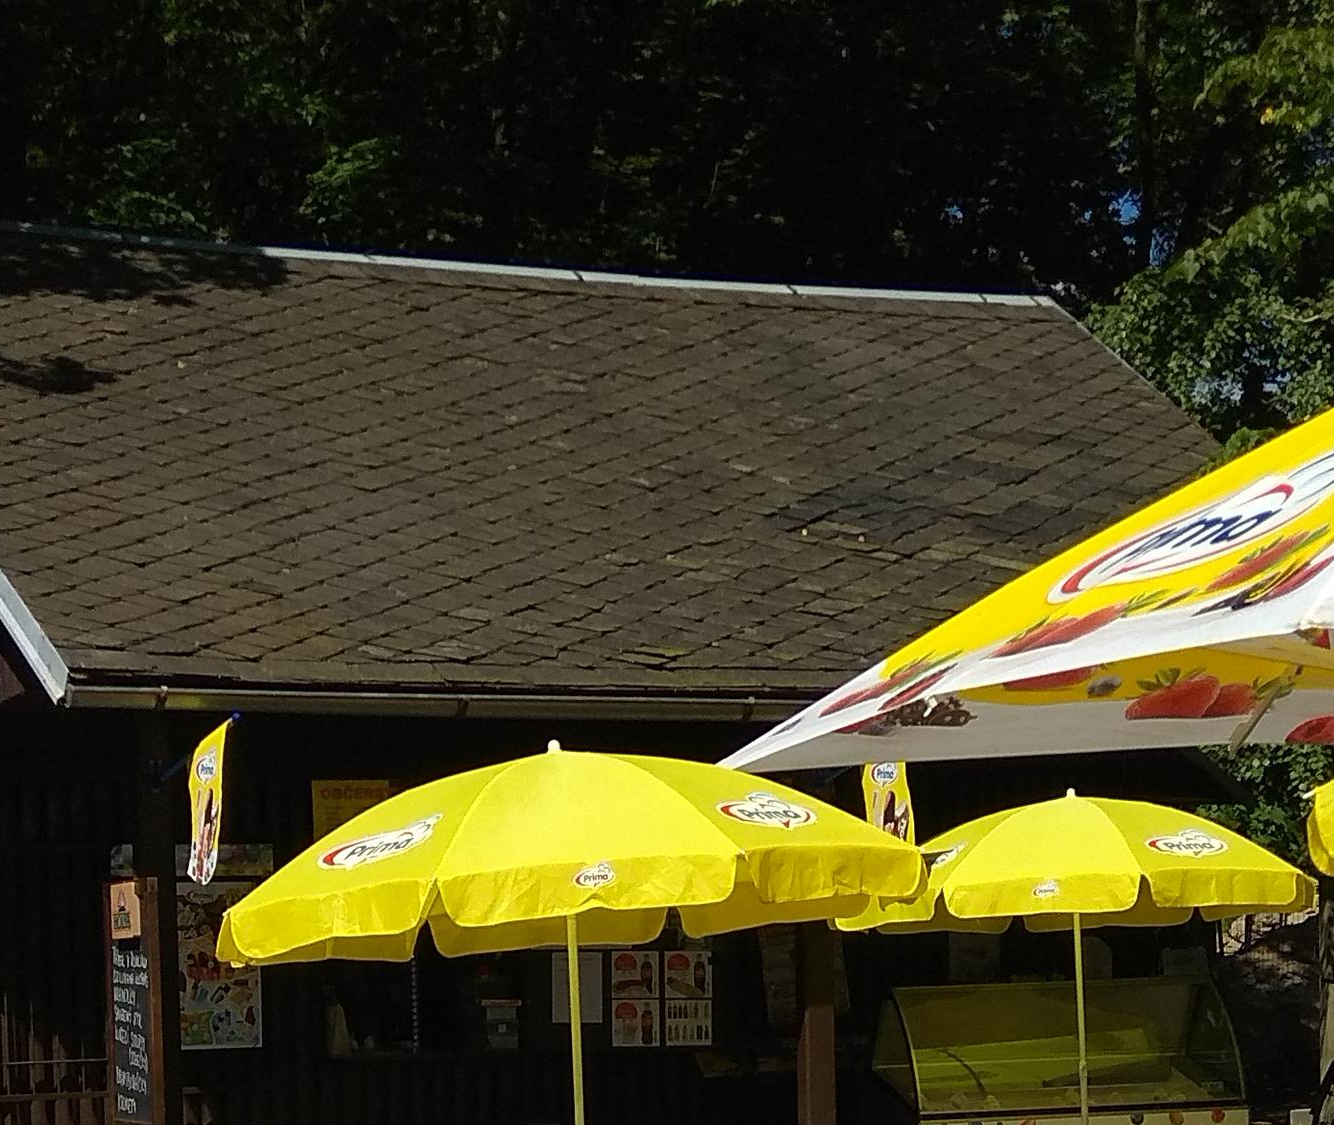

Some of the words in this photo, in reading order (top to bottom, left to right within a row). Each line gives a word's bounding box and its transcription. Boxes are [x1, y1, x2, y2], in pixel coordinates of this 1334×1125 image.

[740, 804, 799, 826] Prima
[343, 836, 415, 862] Prima
[1163, 840, 1216, 852] Prima
[581, 871, 610, 884] Prima
